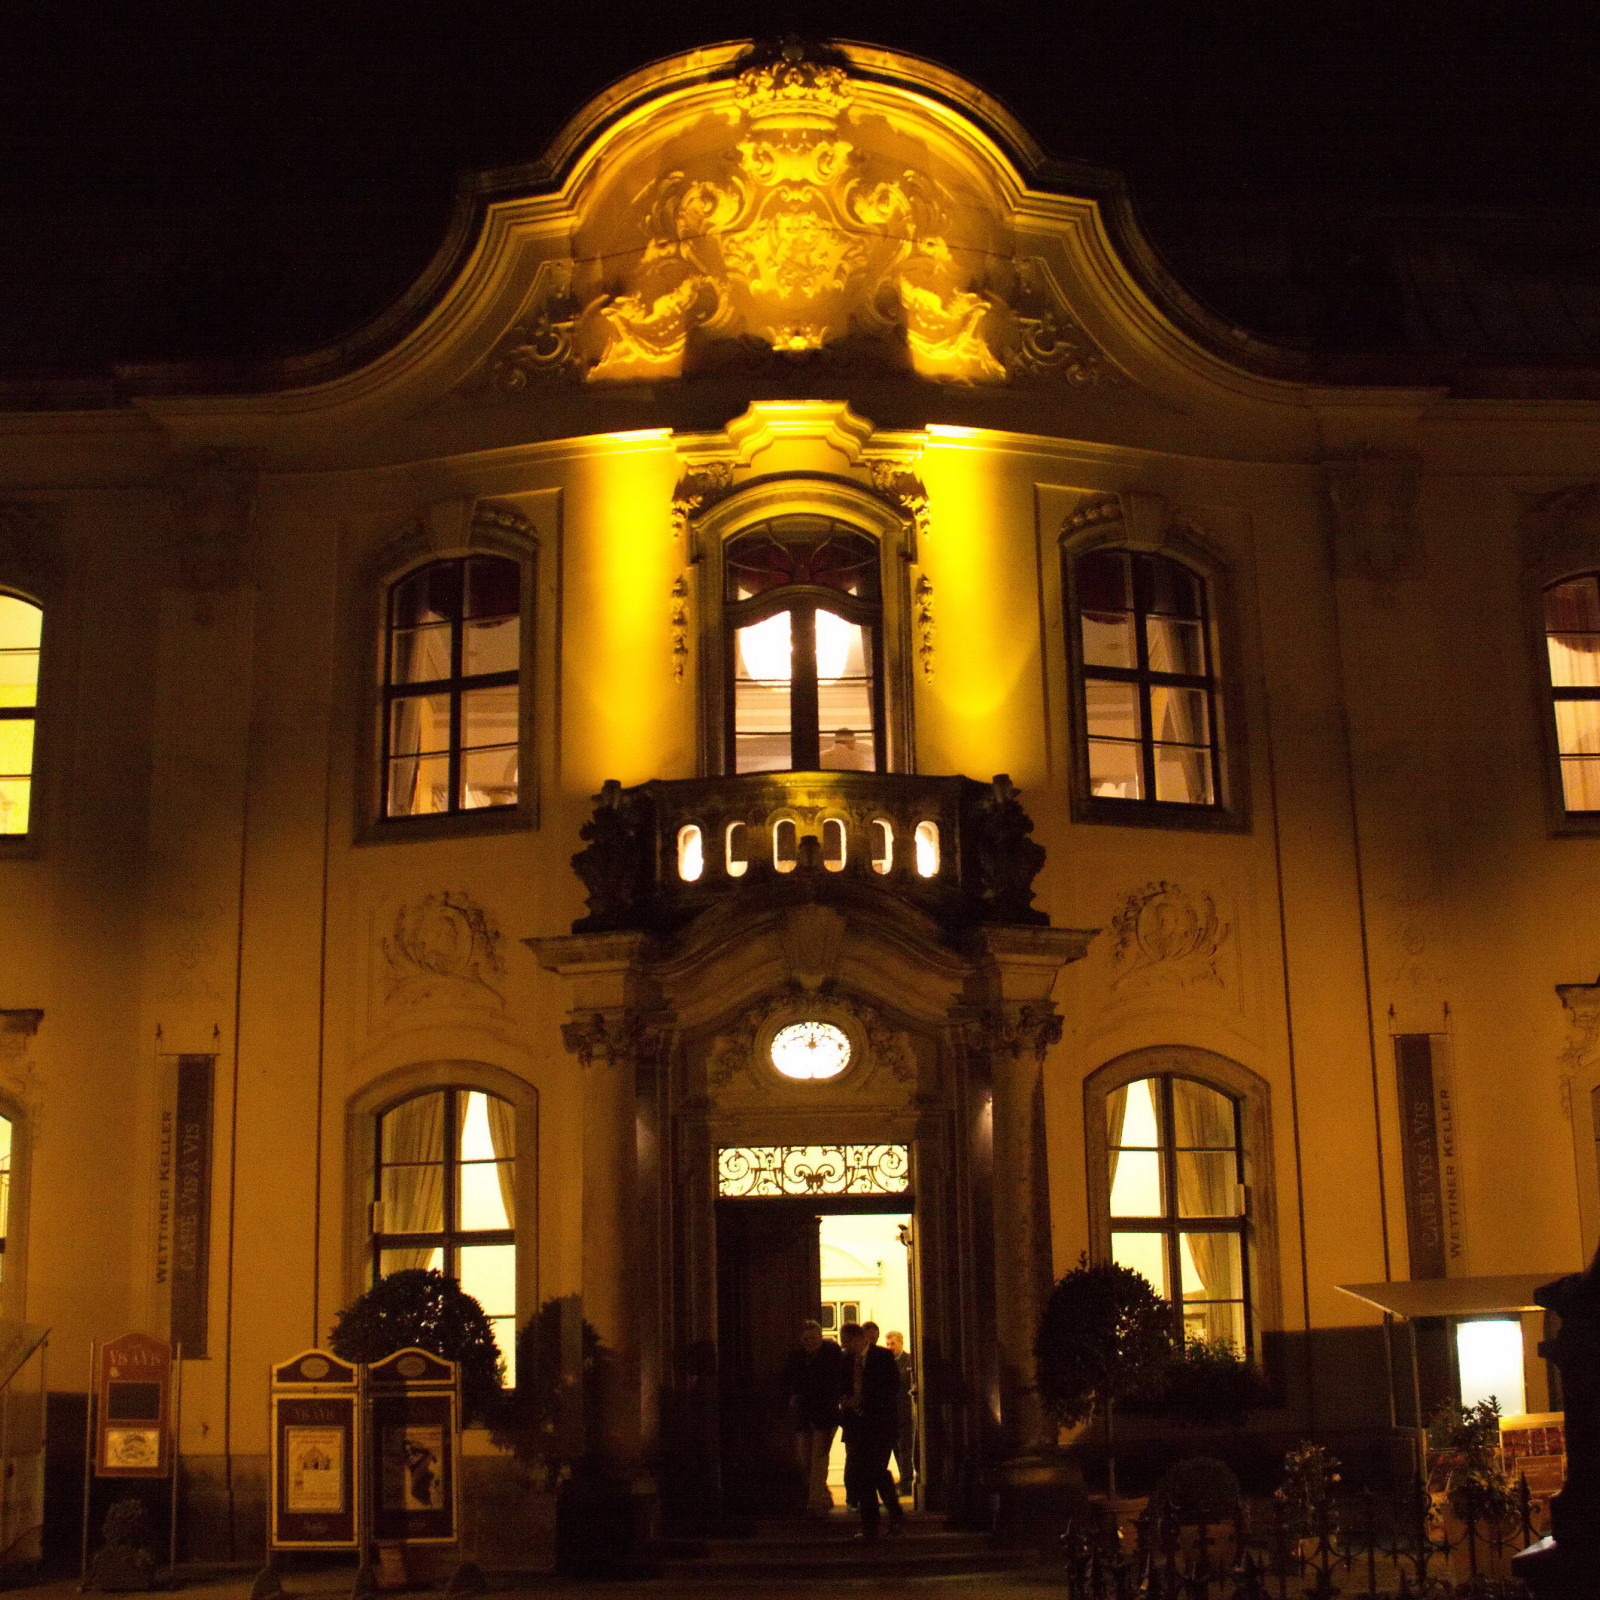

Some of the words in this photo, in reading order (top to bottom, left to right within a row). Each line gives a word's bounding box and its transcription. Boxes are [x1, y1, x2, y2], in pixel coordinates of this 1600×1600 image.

[159, 1111, 172, 1181] KELLER
[1440, 1089, 1455, 1157] KELLER
[156, 1189, 170, 1284] WETTINER
[1446, 1165, 1462, 1258] WETTINER
